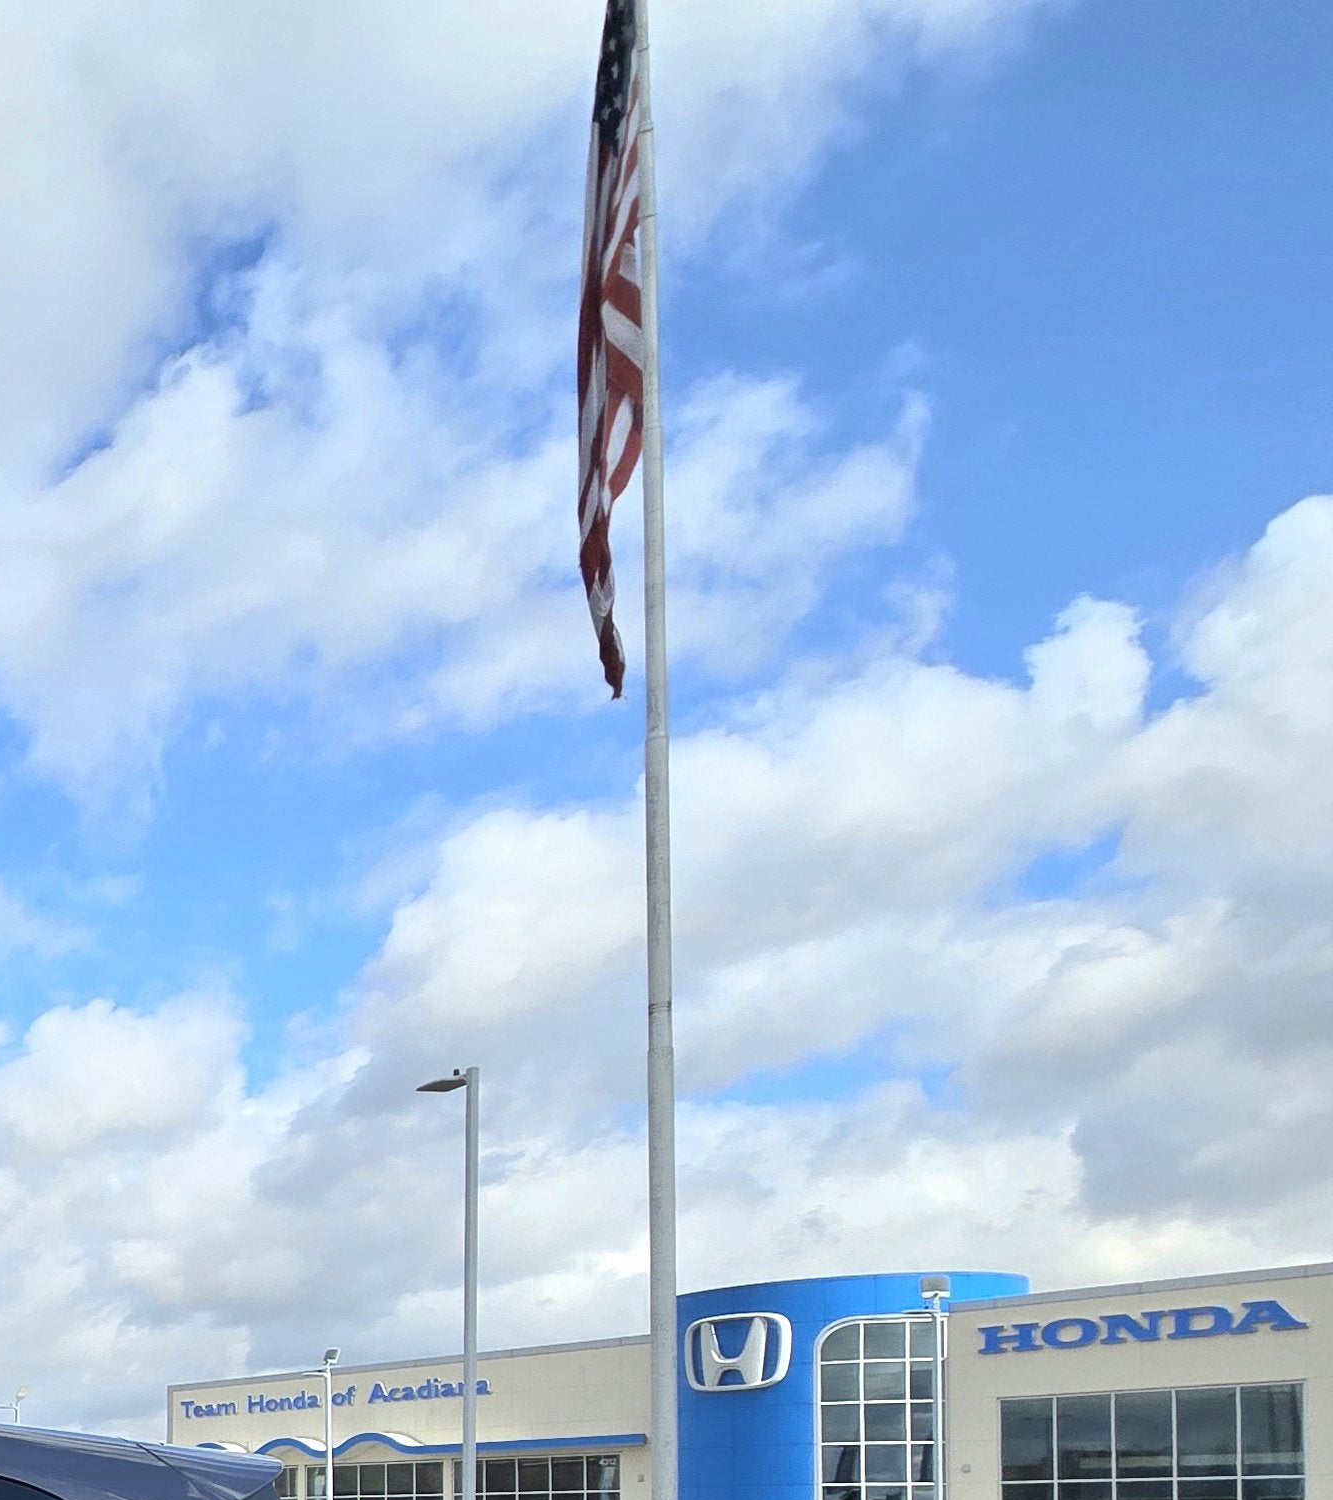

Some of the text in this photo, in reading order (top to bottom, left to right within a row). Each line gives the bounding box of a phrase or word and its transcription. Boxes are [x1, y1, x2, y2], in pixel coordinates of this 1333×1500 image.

[977, 1300, 1309, 1355] HONDA
[180, 1400, 237, 1418] Team
[247, 1390, 321, 1414] Honda
[331, 1385, 356, 1406] of
